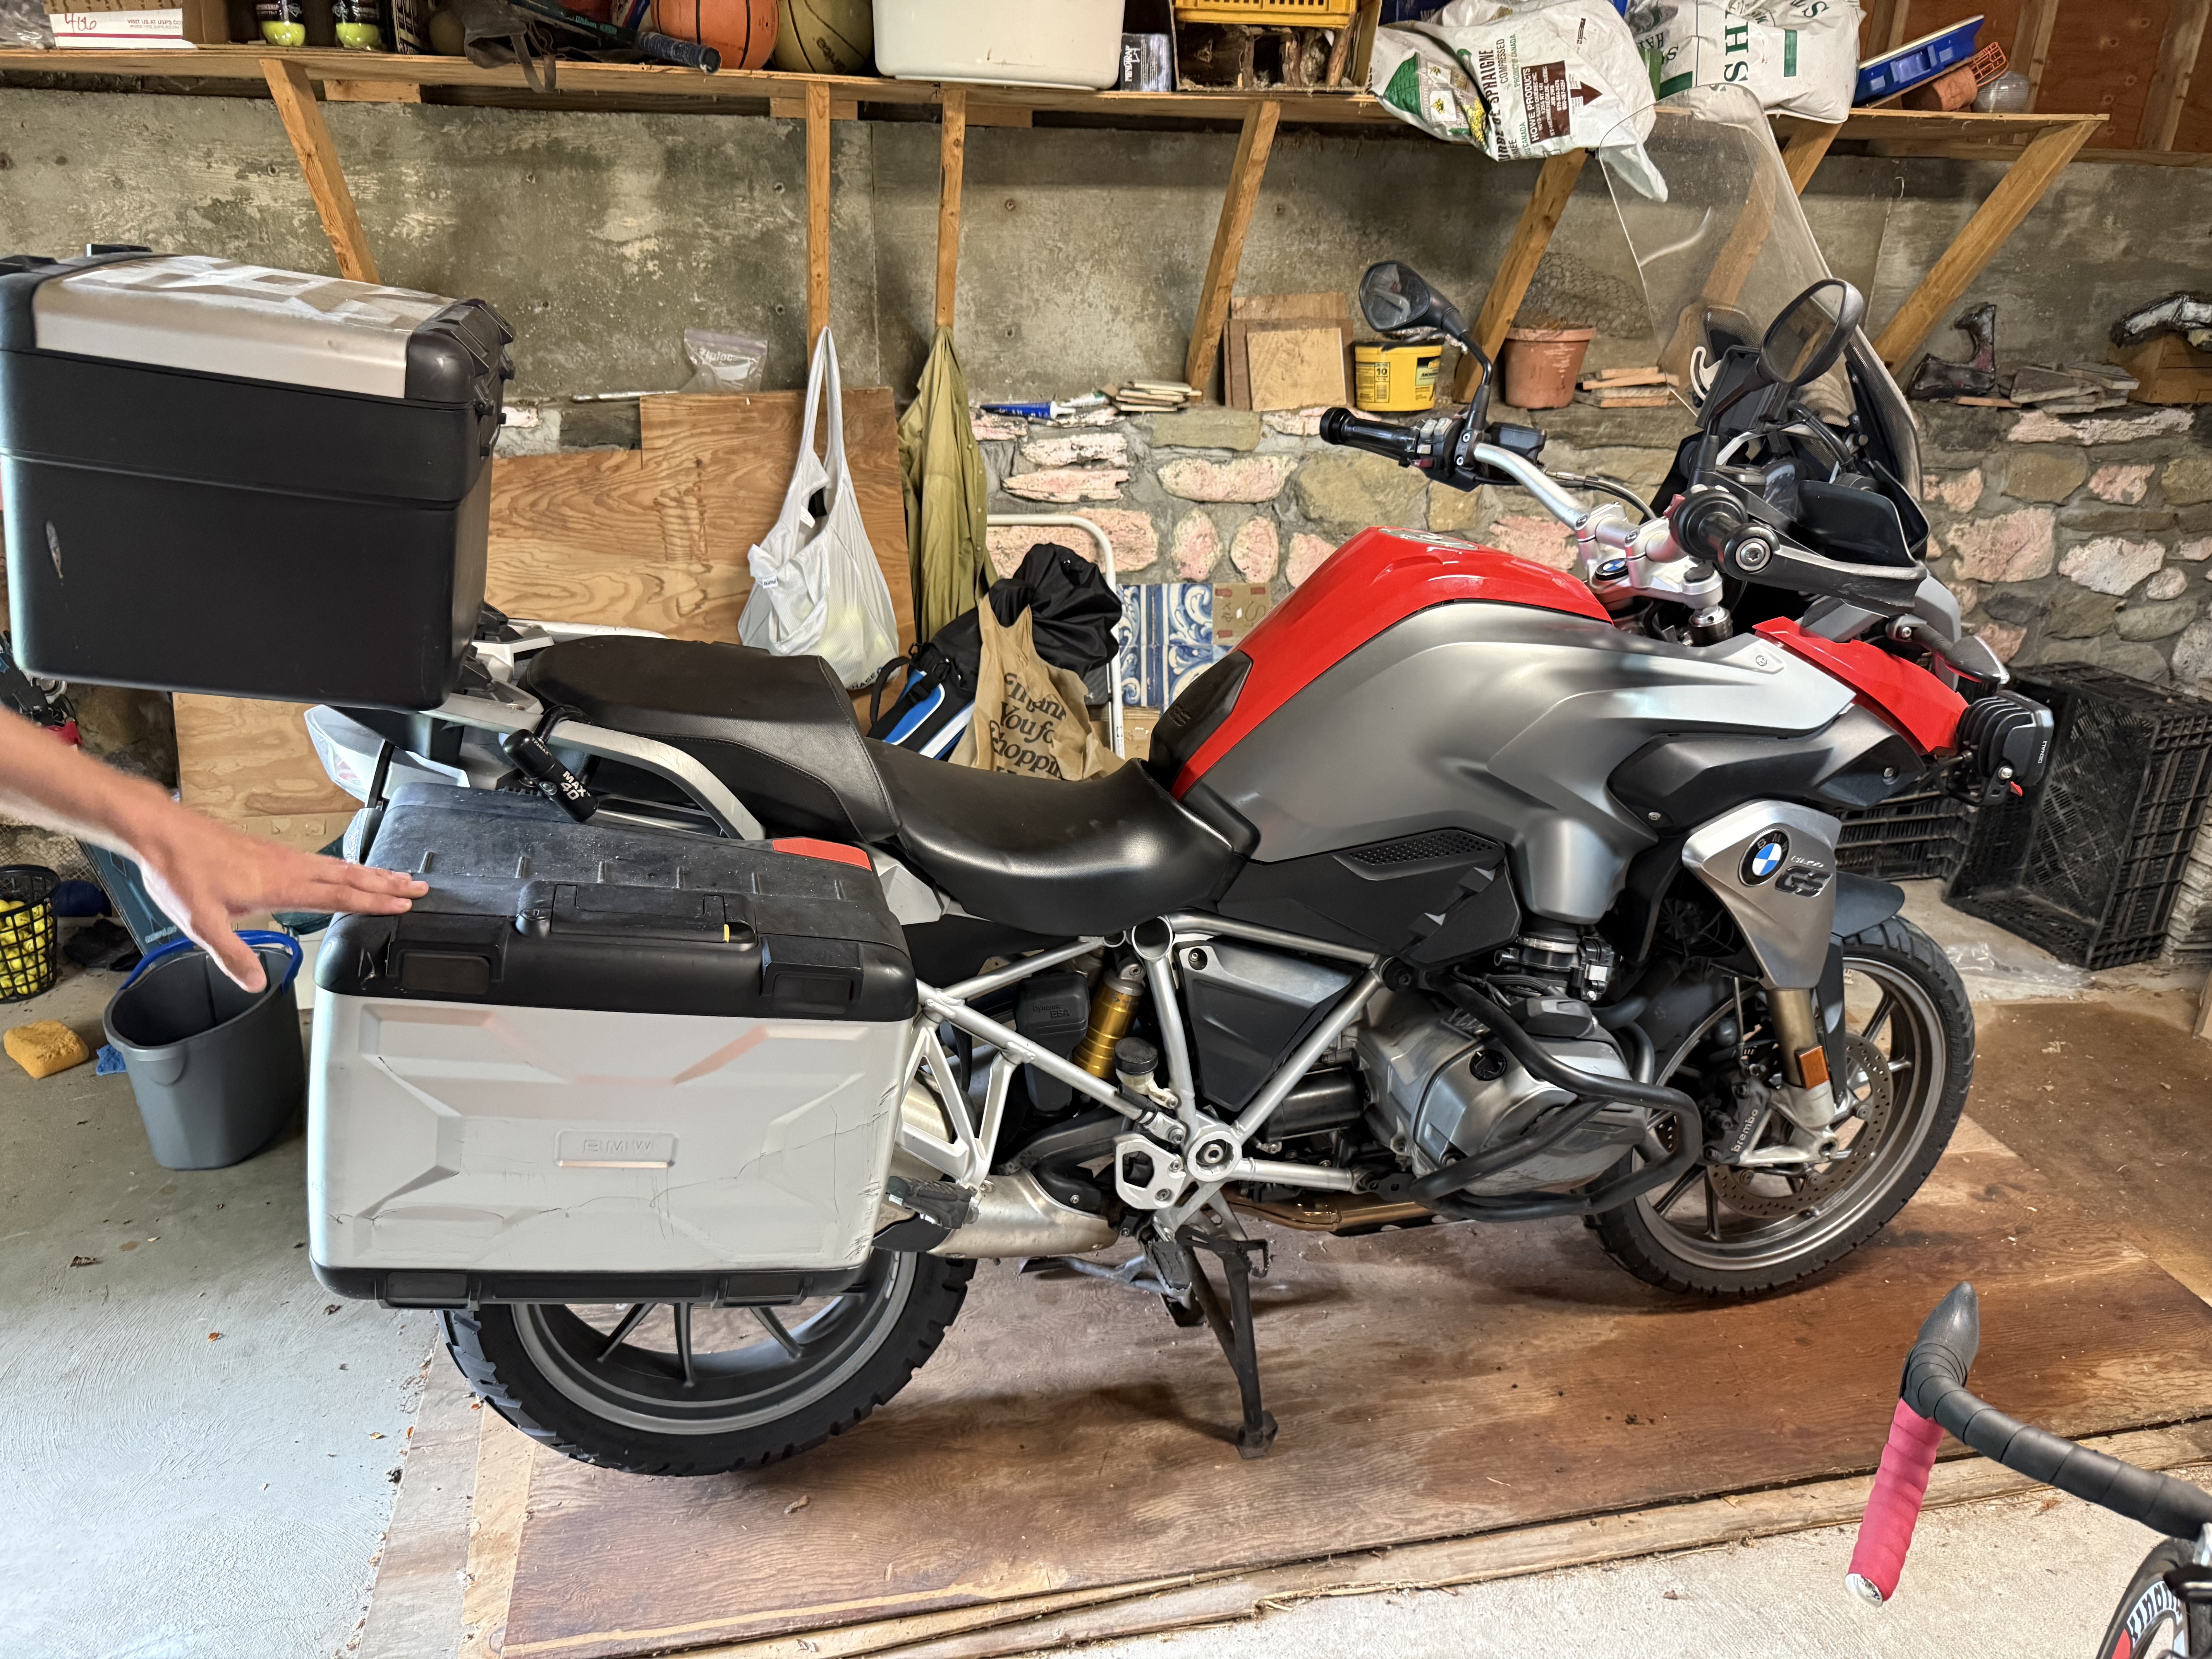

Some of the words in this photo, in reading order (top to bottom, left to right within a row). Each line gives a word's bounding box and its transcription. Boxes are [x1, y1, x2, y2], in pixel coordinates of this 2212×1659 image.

[1496, 38, 1508, 84] COMPRESSED
[1479, 49, 1499, 104] SPHAIGNE
[1512, 64, 1520, 88] PRODUCT
[1523, 68, 1535, 111] PRODUCTS
[1519, 122, 1529, 148] CANADA
[1528, 112, 1540, 142] HOWE
[852, 672, 876, 689] HASE
[1000, 701, 1036, 735] You
[1024, 721, 1055, 748] fo
[532, 737, 551, 756] TRIMAX
[2037, 740, 2047, 763] DENALI
[560, 782, 579, 800] 40
[563, 771, 586, 797] MAX
[1757, 833, 1788, 853] BMW
[1775, 866, 1833, 898] GS
[1033, 1003, 1061, 1013] Dynamic
[1050, 1008, 1070, 1018] ESA
[1731, 1109, 1758, 1152] brembo
[583, 1139, 653, 1153] BMW
